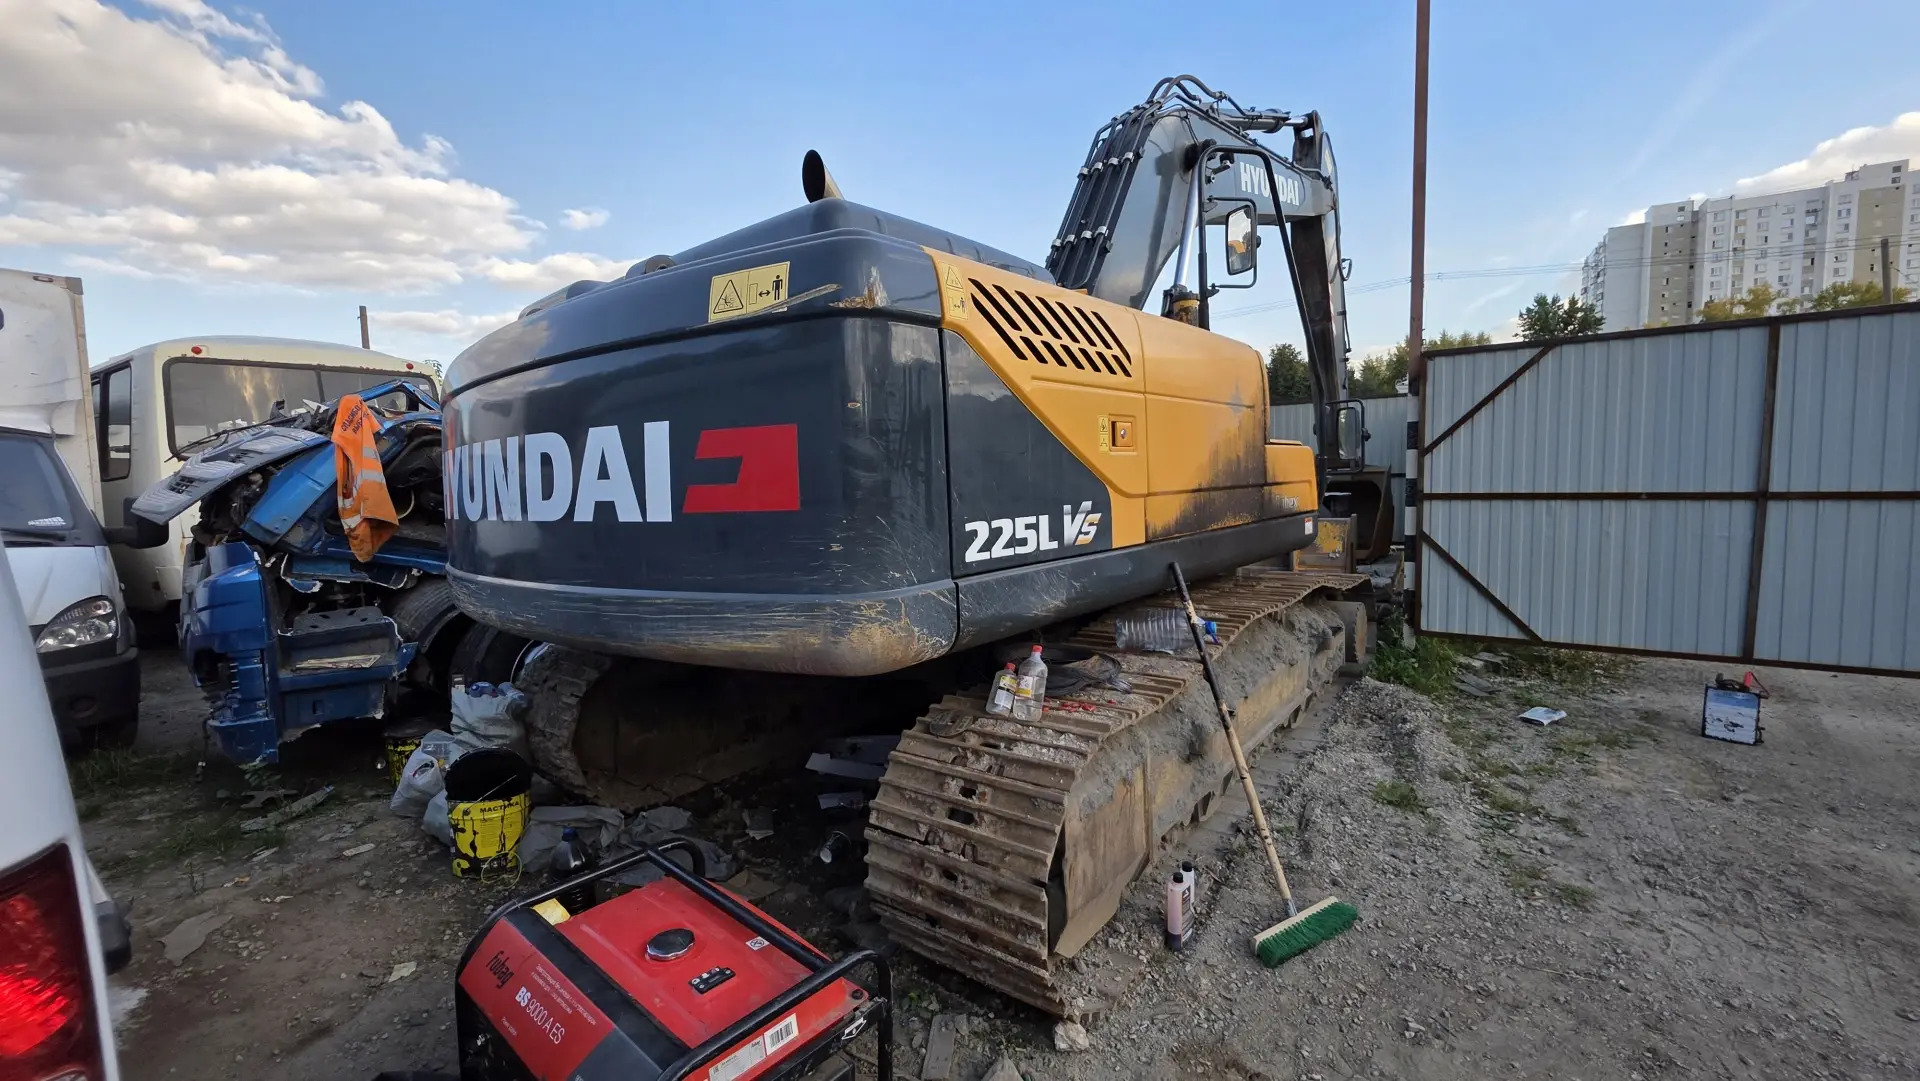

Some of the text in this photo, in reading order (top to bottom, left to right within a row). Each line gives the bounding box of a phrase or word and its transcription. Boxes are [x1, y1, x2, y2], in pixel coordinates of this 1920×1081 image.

[442, 420, 673, 522] HYUNDAI
[964, 515, 1059, 563] 225L
[479, 801, 520, 814] МАСТИКА
[485, 950, 515, 989] fubag
[515, 986, 565, 1045] BS 9000 A ES
